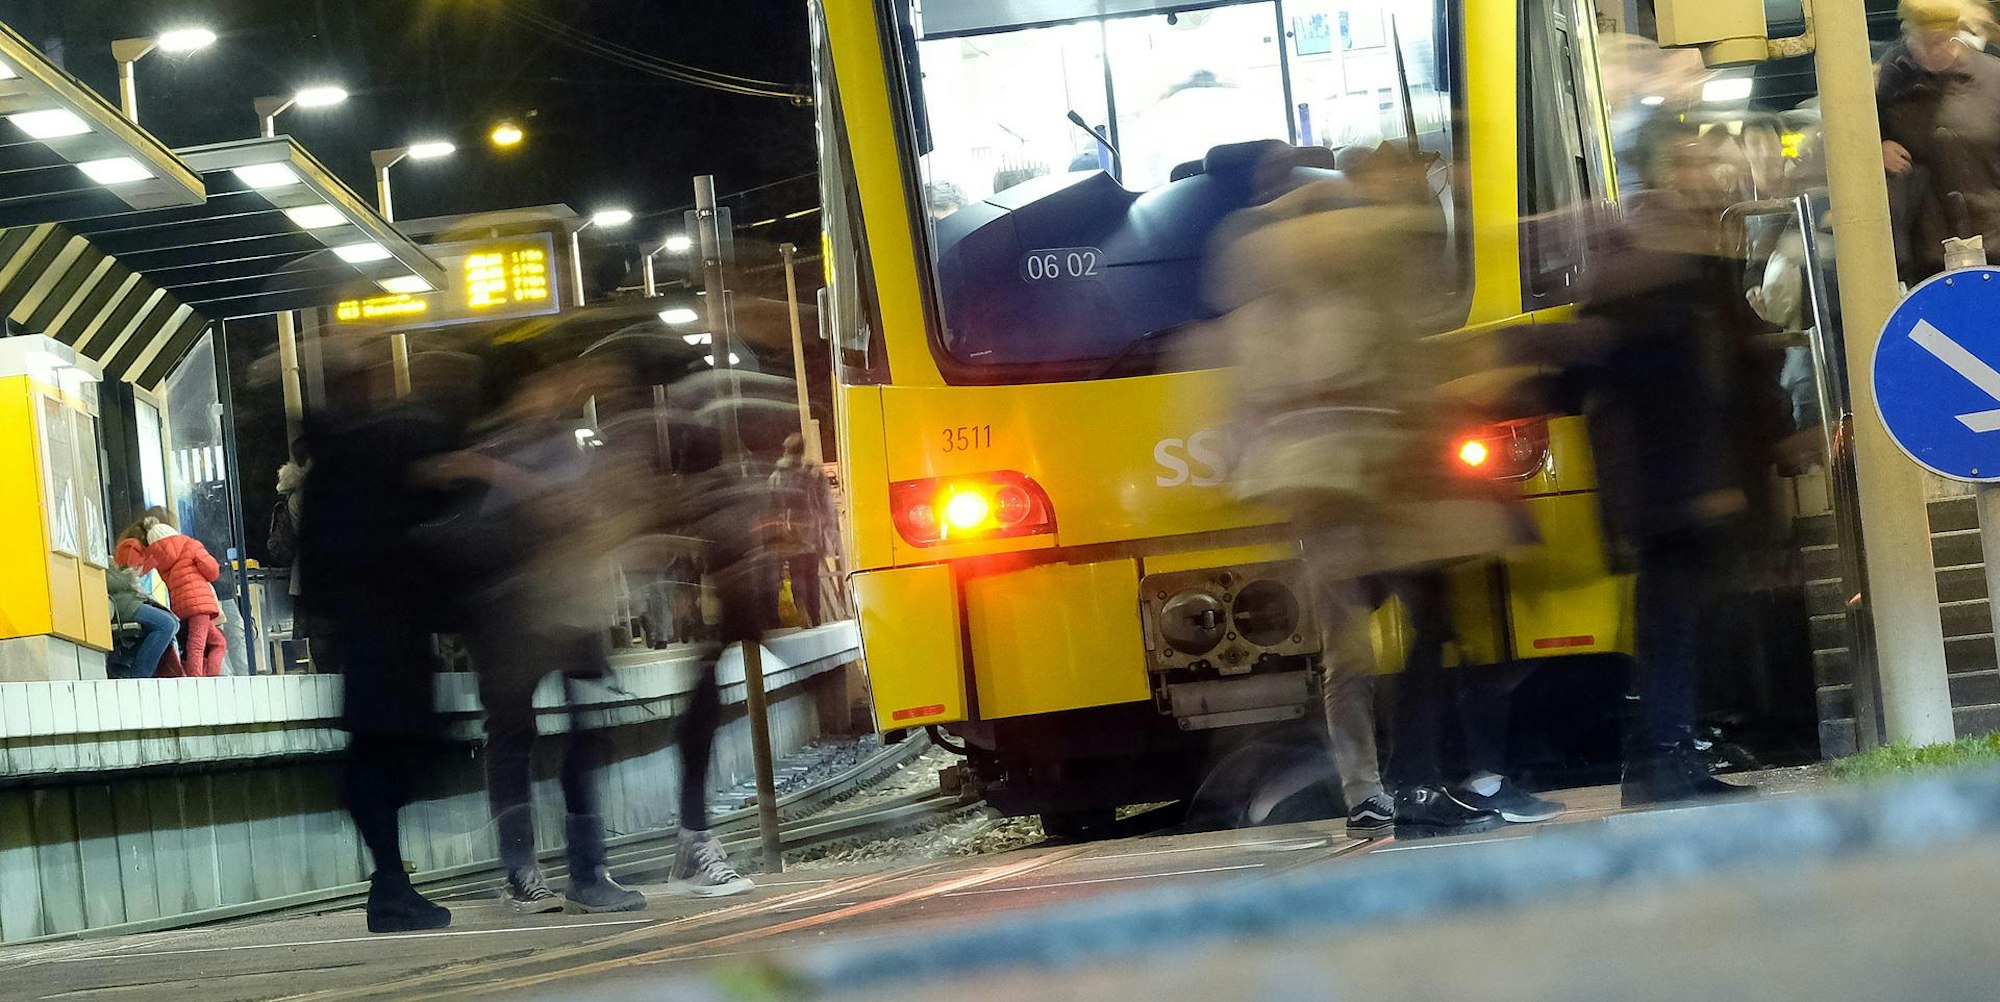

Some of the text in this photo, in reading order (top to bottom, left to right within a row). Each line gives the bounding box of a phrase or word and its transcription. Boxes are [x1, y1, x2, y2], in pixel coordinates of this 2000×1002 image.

[1027, 251, 1099, 280] 06 02
[942, 424, 991, 453] 3511
